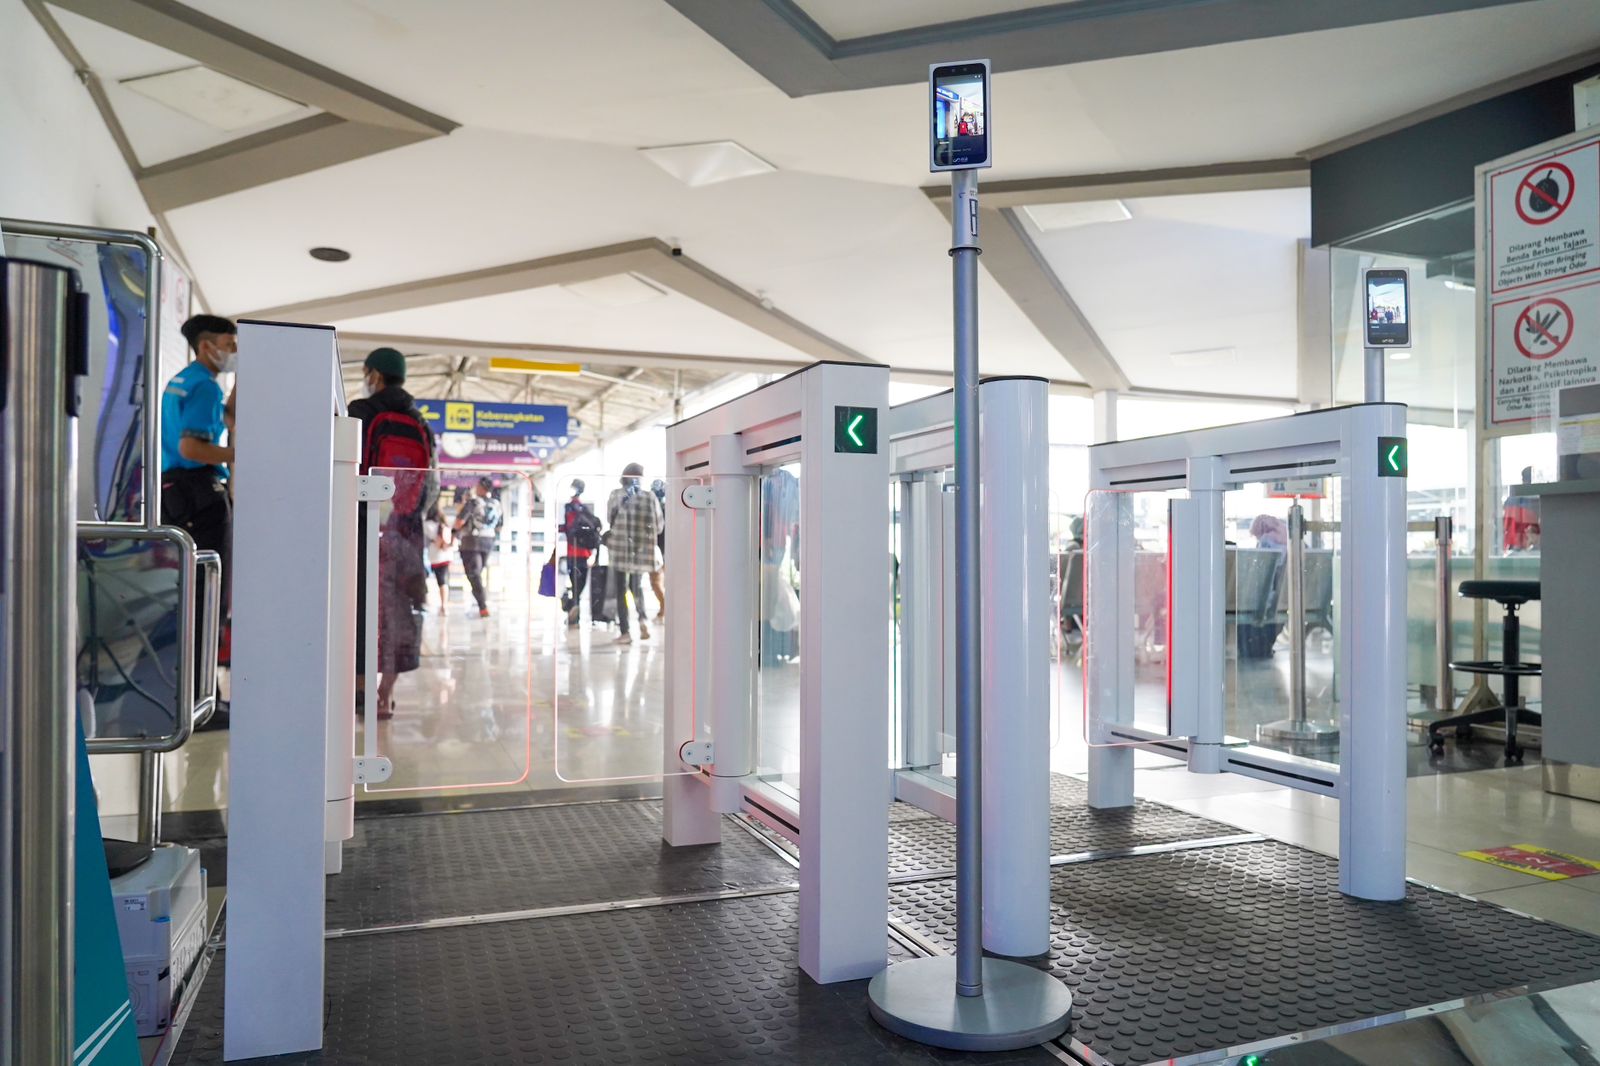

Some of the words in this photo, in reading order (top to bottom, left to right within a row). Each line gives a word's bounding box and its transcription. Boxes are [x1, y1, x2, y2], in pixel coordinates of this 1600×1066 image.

[1506, 252, 1530, 263] Benda
[1532, 245, 1560, 257] Berbau
[1563, 238, 1588, 250] Tajam
[1509, 240, 1542, 253] Dilarang
[1544, 229, 1585, 244] Membawa
[1500, 263, 1535, 277] Prohibited
[1536, 259, 1554, 269] From
[1556, 251, 1586, 264] Bringing
[1498, 276, 1523, 287] Objects
[1525, 270, 1542, 281] With
[1544, 265, 1567, 276] Strong
[1507, 364, 1542, 375] Dilarang
[1544, 357, 1588, 369] Membawa
[1544, 365, 1597, 379] Psikotropika
[1499, 386, 1514, 395] dan
[1517, 384, 1530, 393] zat
